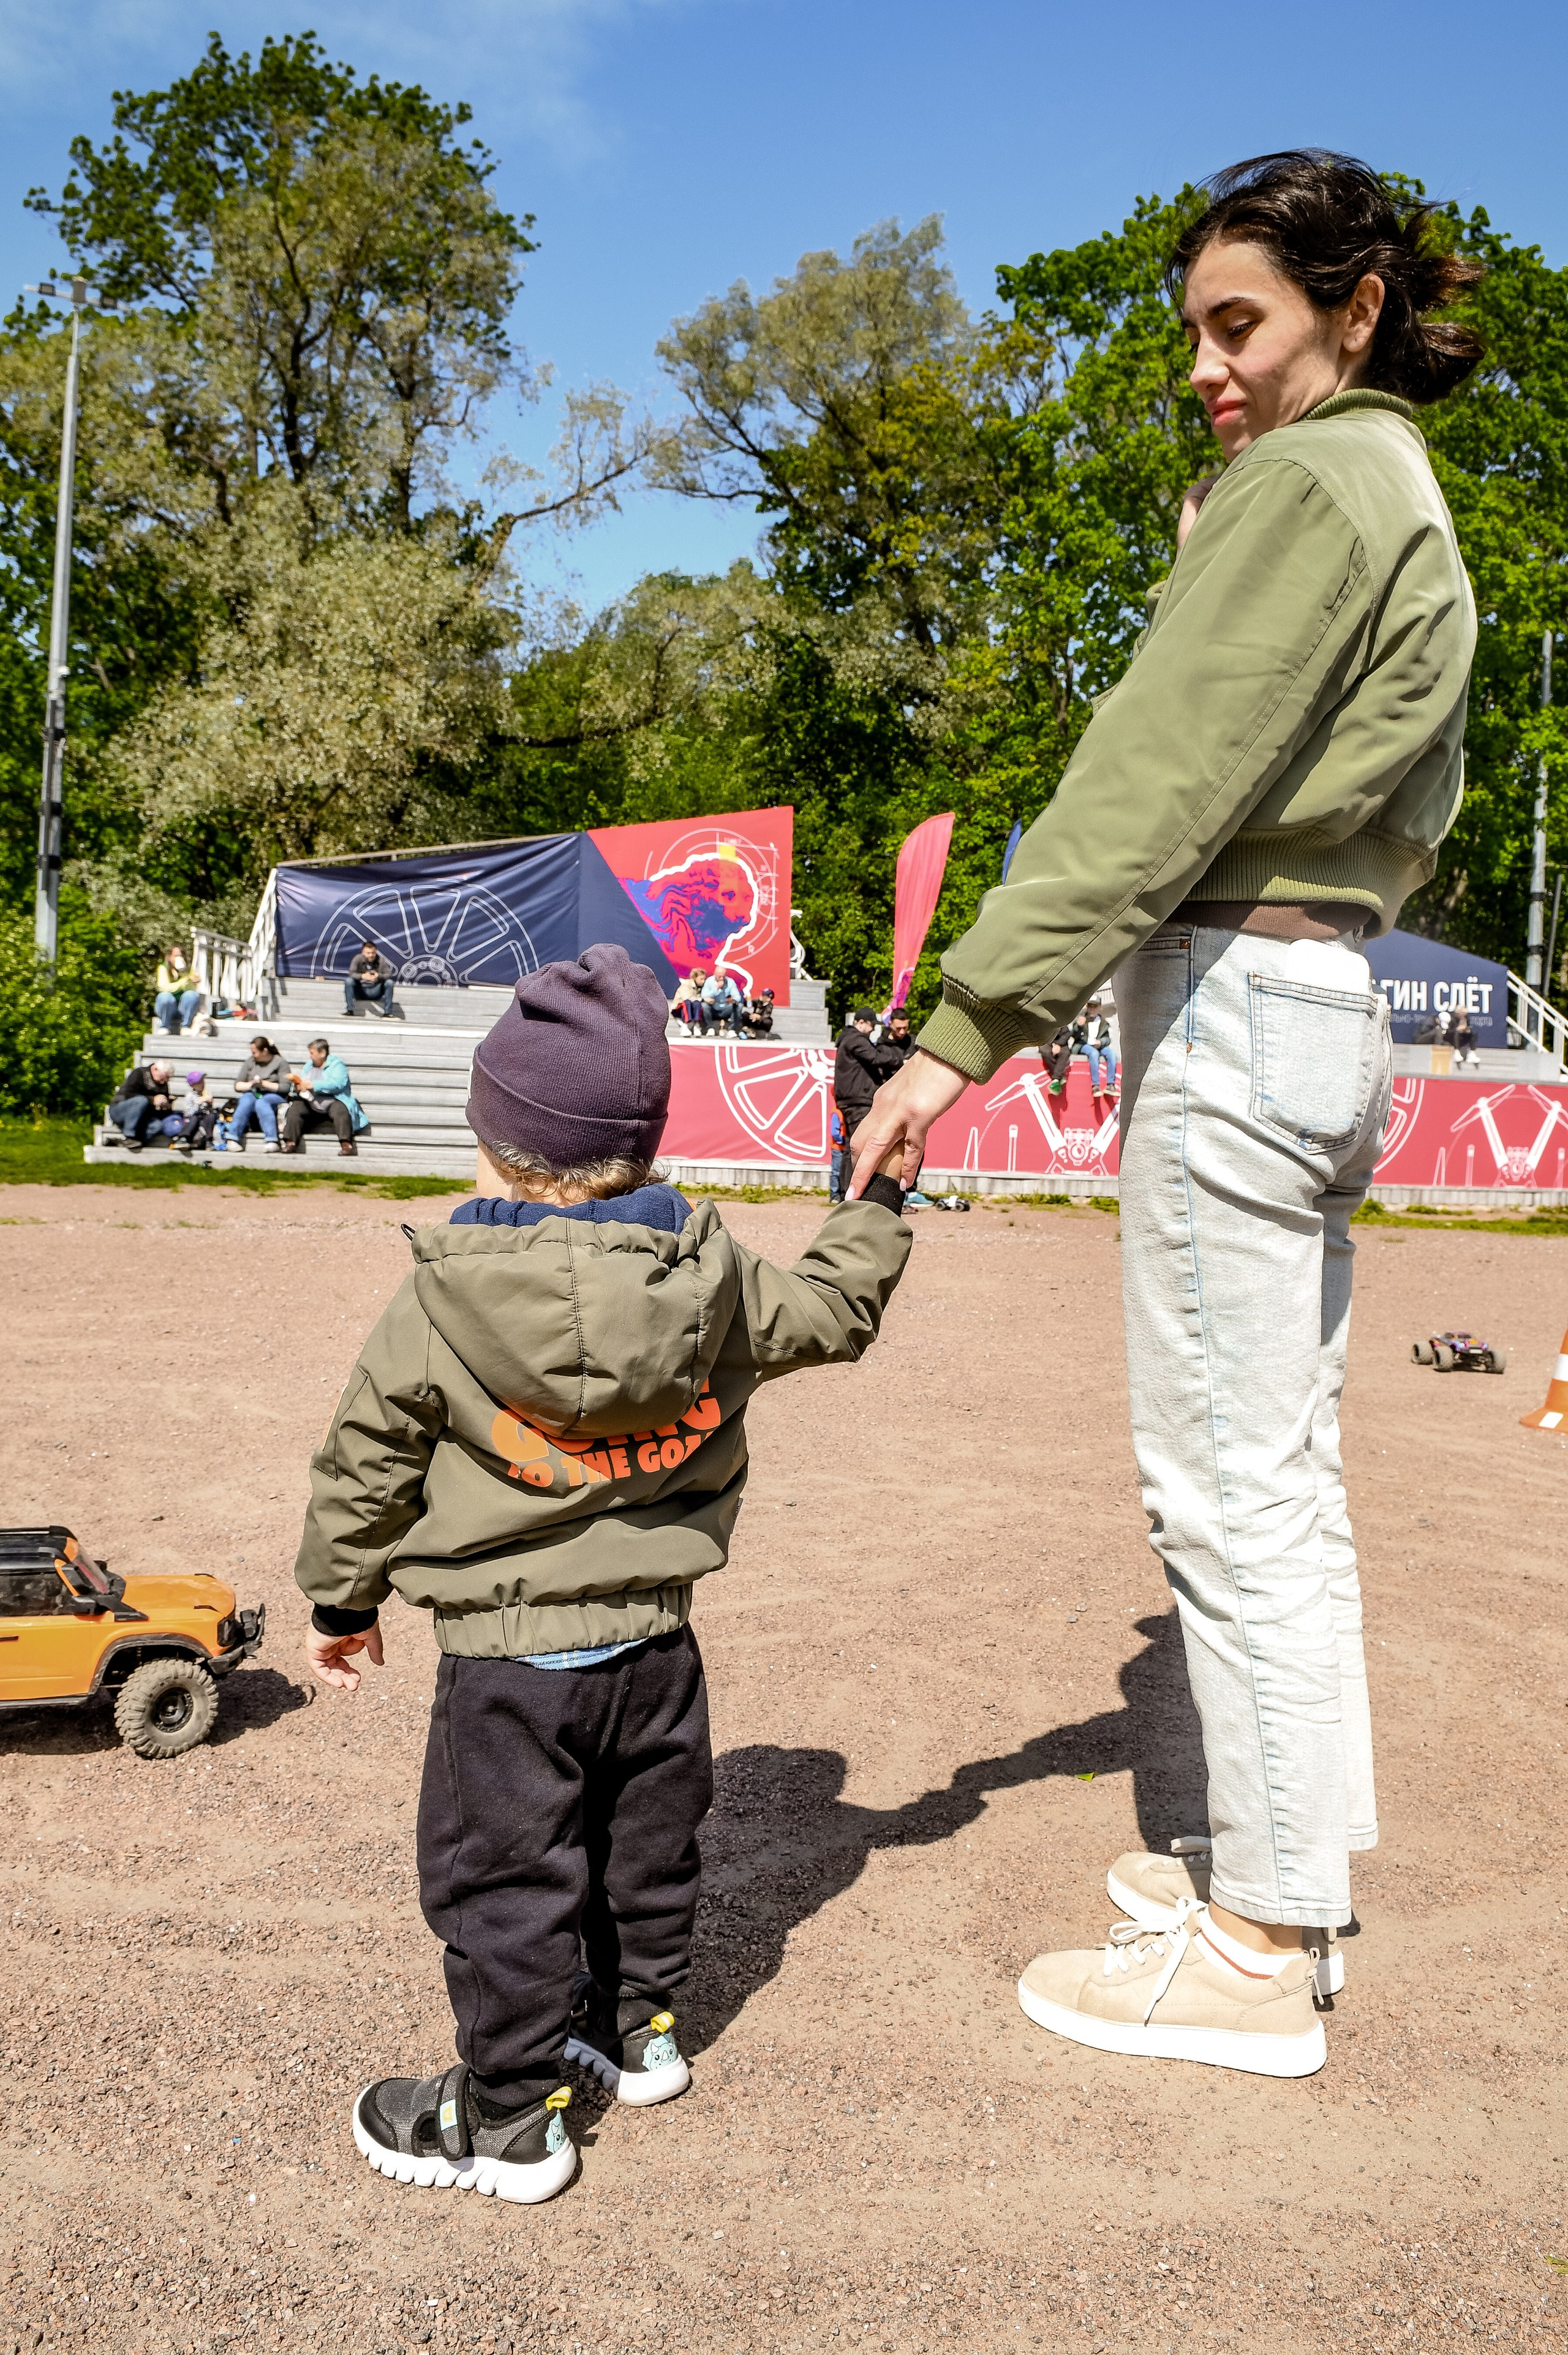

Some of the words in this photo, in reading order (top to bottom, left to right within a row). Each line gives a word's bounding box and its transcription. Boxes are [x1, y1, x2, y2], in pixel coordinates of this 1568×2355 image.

[1372, 979, 1428, 1012] ГИН
[1433, 976, 1493, 1014] СЛЁТ
[560, 1447, 631, 1487] THE
